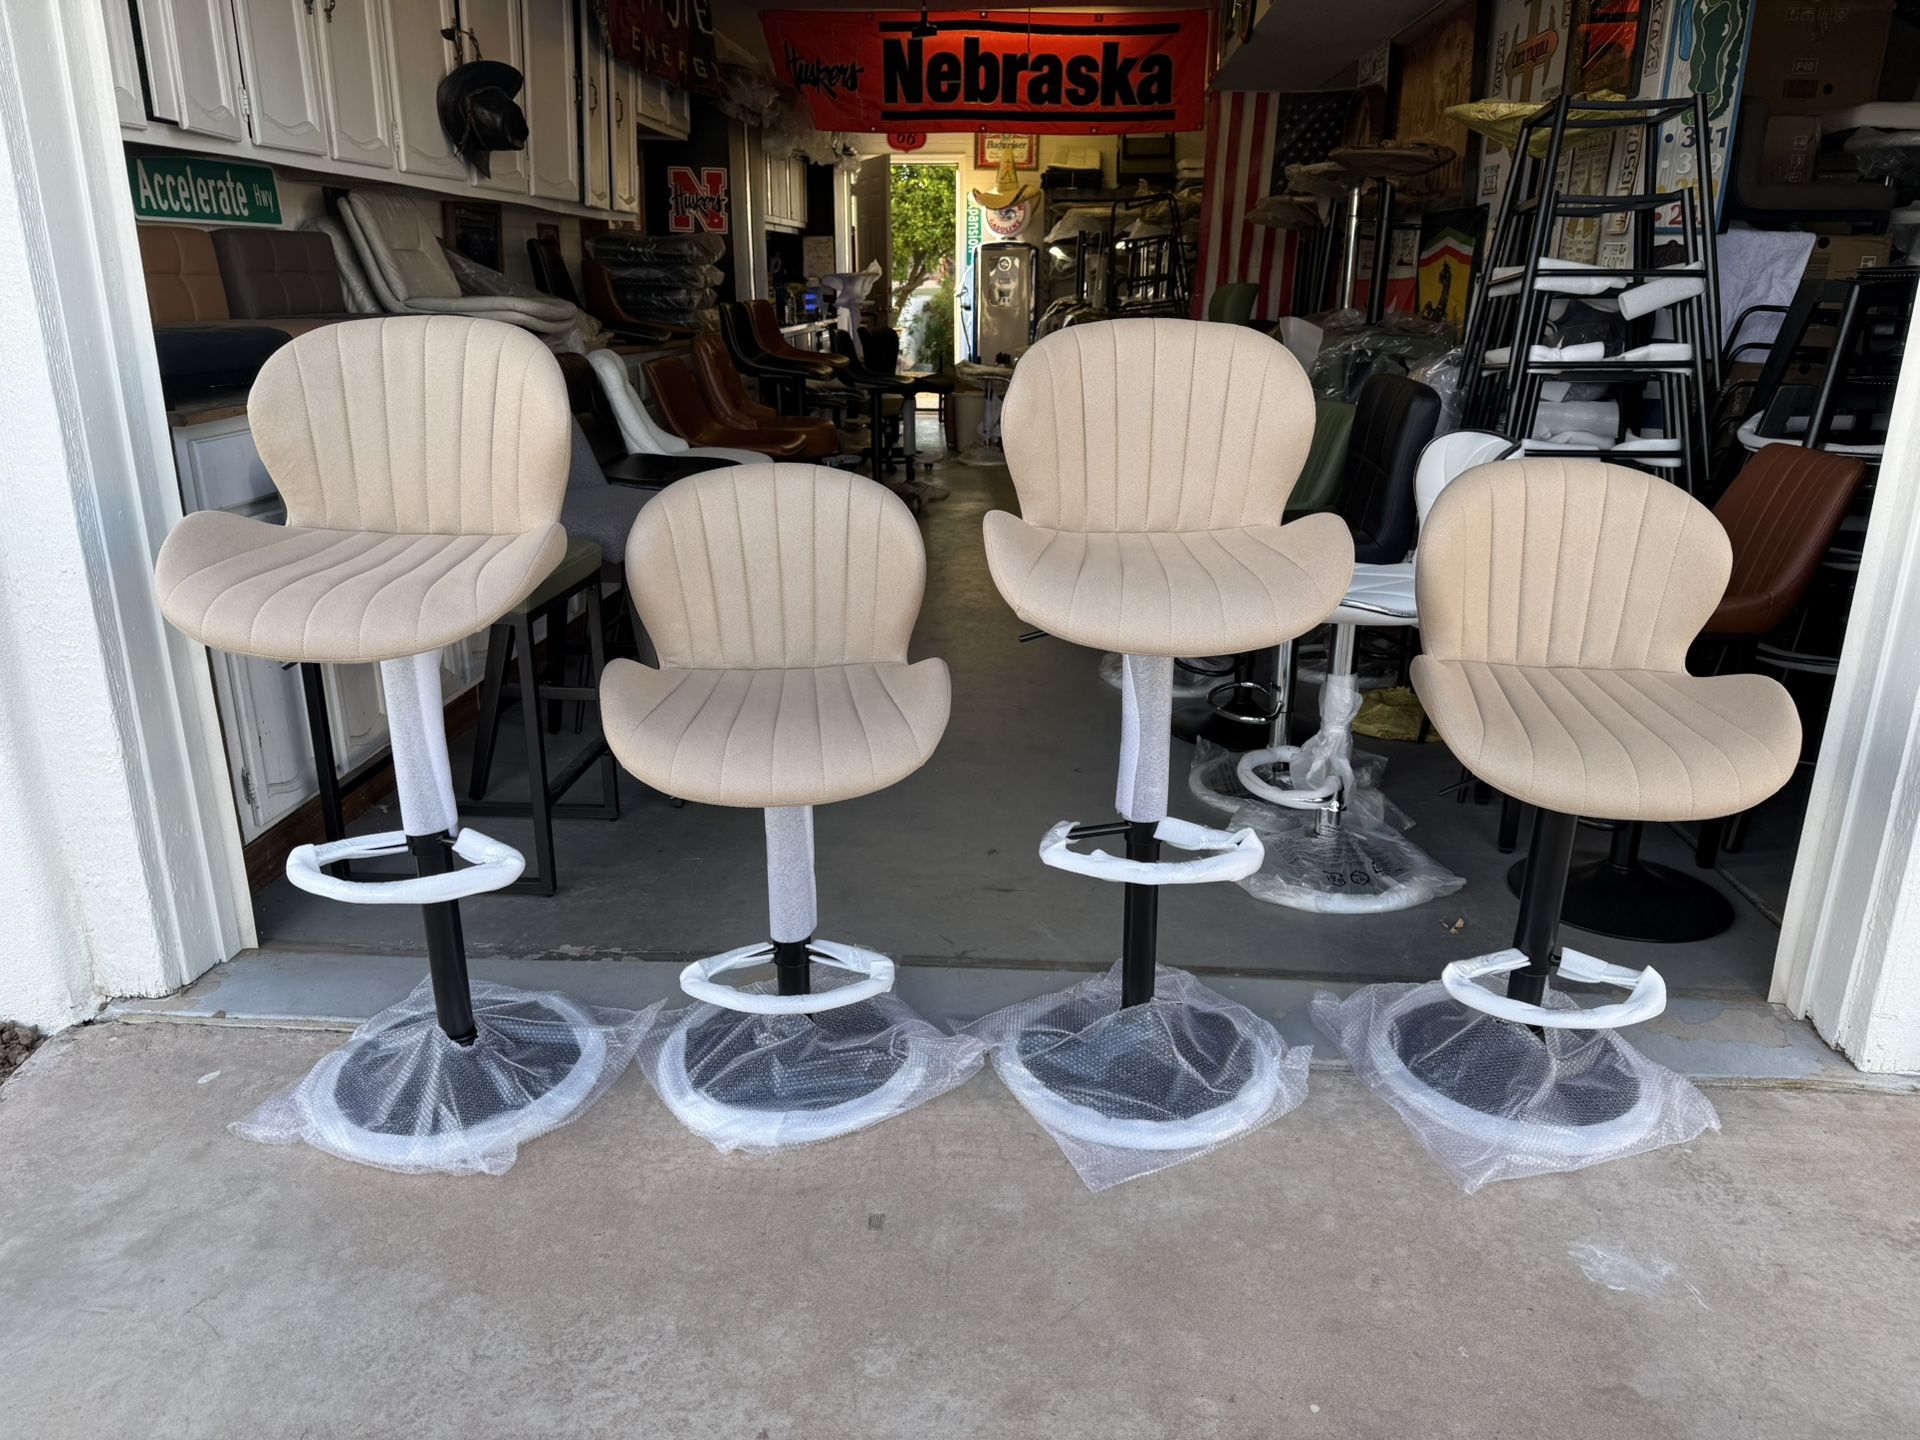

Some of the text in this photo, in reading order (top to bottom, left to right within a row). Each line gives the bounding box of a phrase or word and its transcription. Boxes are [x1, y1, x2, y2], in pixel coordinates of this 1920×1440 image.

[784, 40, 865, 98] Huskers
[883, 37, 1173, 106] Nebraska
[136, 158, 274, 217] Accelerate Hwy
[1677, 152, 1722, 174] 39
